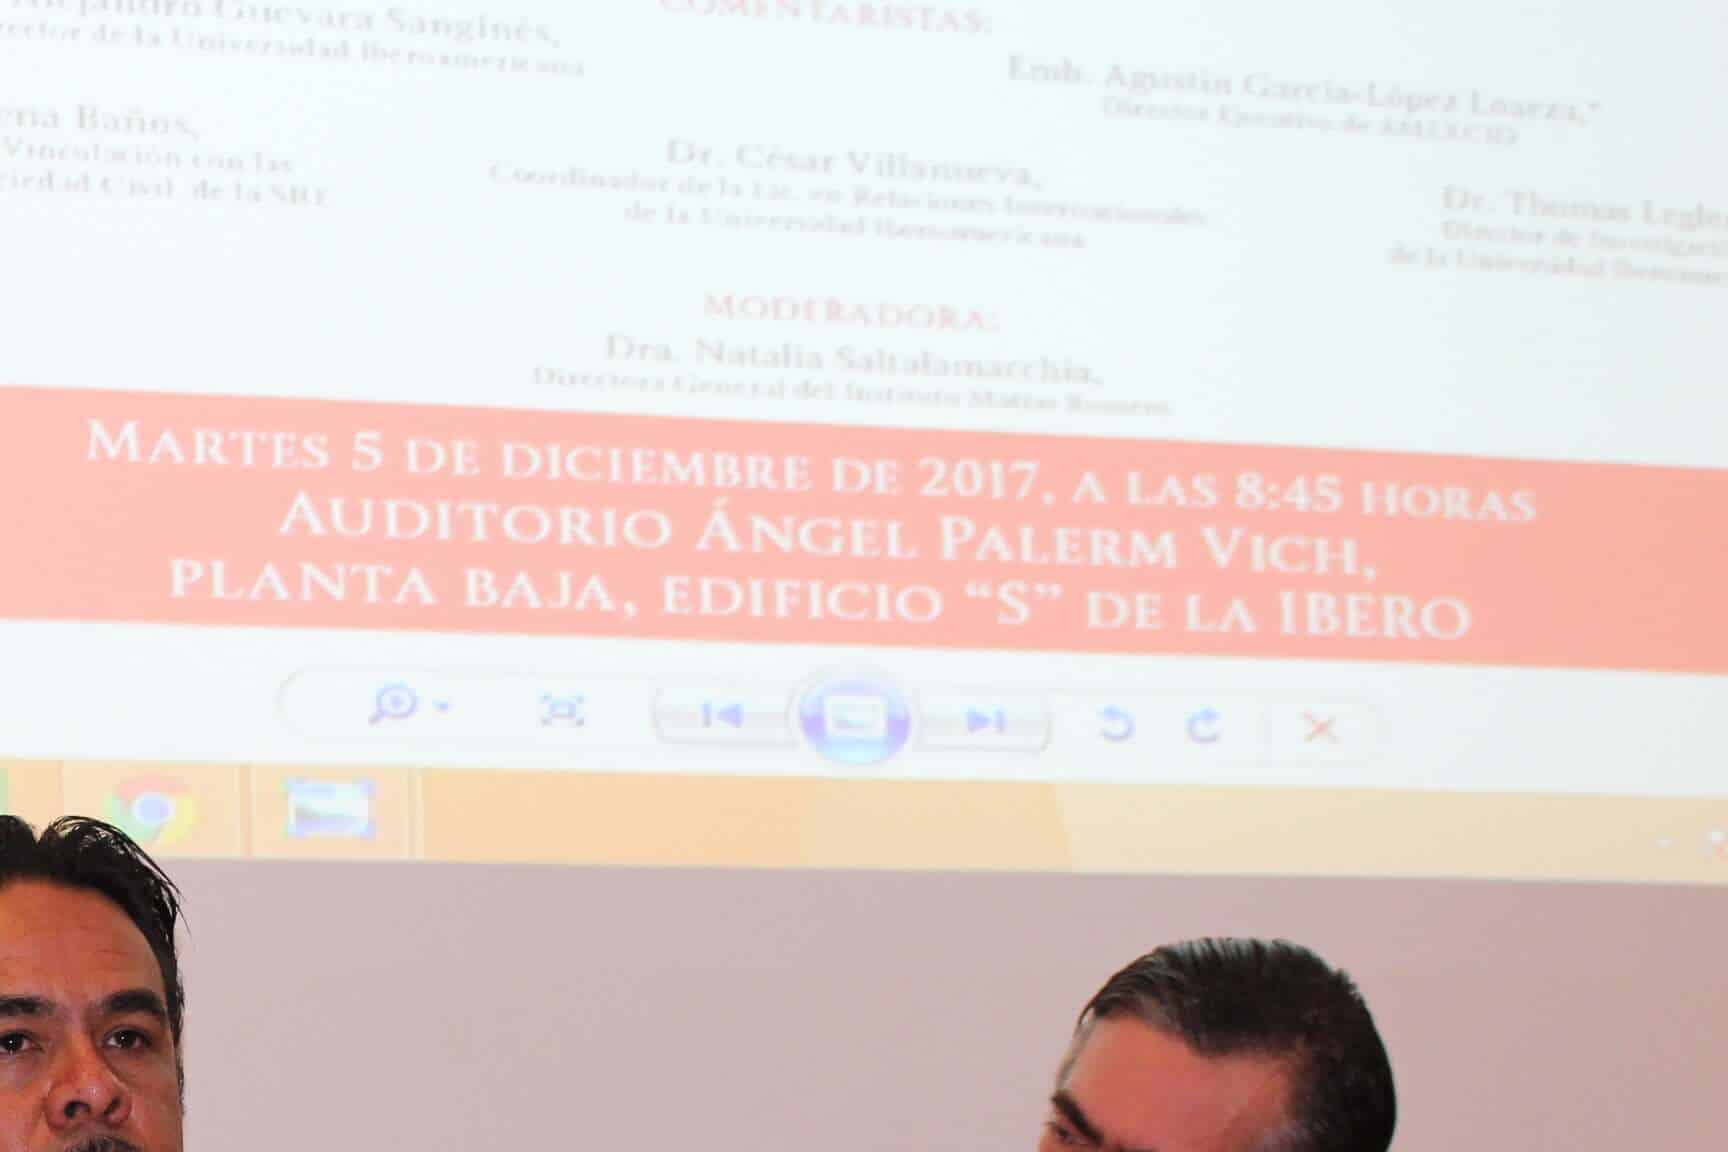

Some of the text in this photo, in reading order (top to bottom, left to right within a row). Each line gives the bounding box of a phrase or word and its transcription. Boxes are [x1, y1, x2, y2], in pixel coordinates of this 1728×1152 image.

[92, 24, 128, 43] de
[134, 24, 162, 48] la
[76, 103, 201, 143] Baños,
[254, 151, 294, 174] las
[667, 137, 1045, 192] Dr. César Villanueva,
[192, 178, 225, 201] de
[232, 182, 262, 203] la
[1439, 183, 1496, 214] Dr.
[1505, 188, 1631, 223] Thomas
[702, 292, 999, 334] MODERADORA:
[603, 332, 680, 364] Dra.
[694, 337, 824, 372] Natalia
[86, 418, 1539, 524] MARTES 5 DE DICIEMBRE DE 2017, A LAS 8:45 HORAS
[278, 490, 1378, 581] AUDITORIO ÁNGEL PALERM VICH,
[168, 558, 439, 606] PLANTA
[463, 567, 640, 620] BAJA,
[662, 574, 945, 625] EDIFICIO
[1085, 590, 1165, 632] DE
[1185, 593, 1259, 634] LA
[1280, 590, 1472, 640] IBERO
